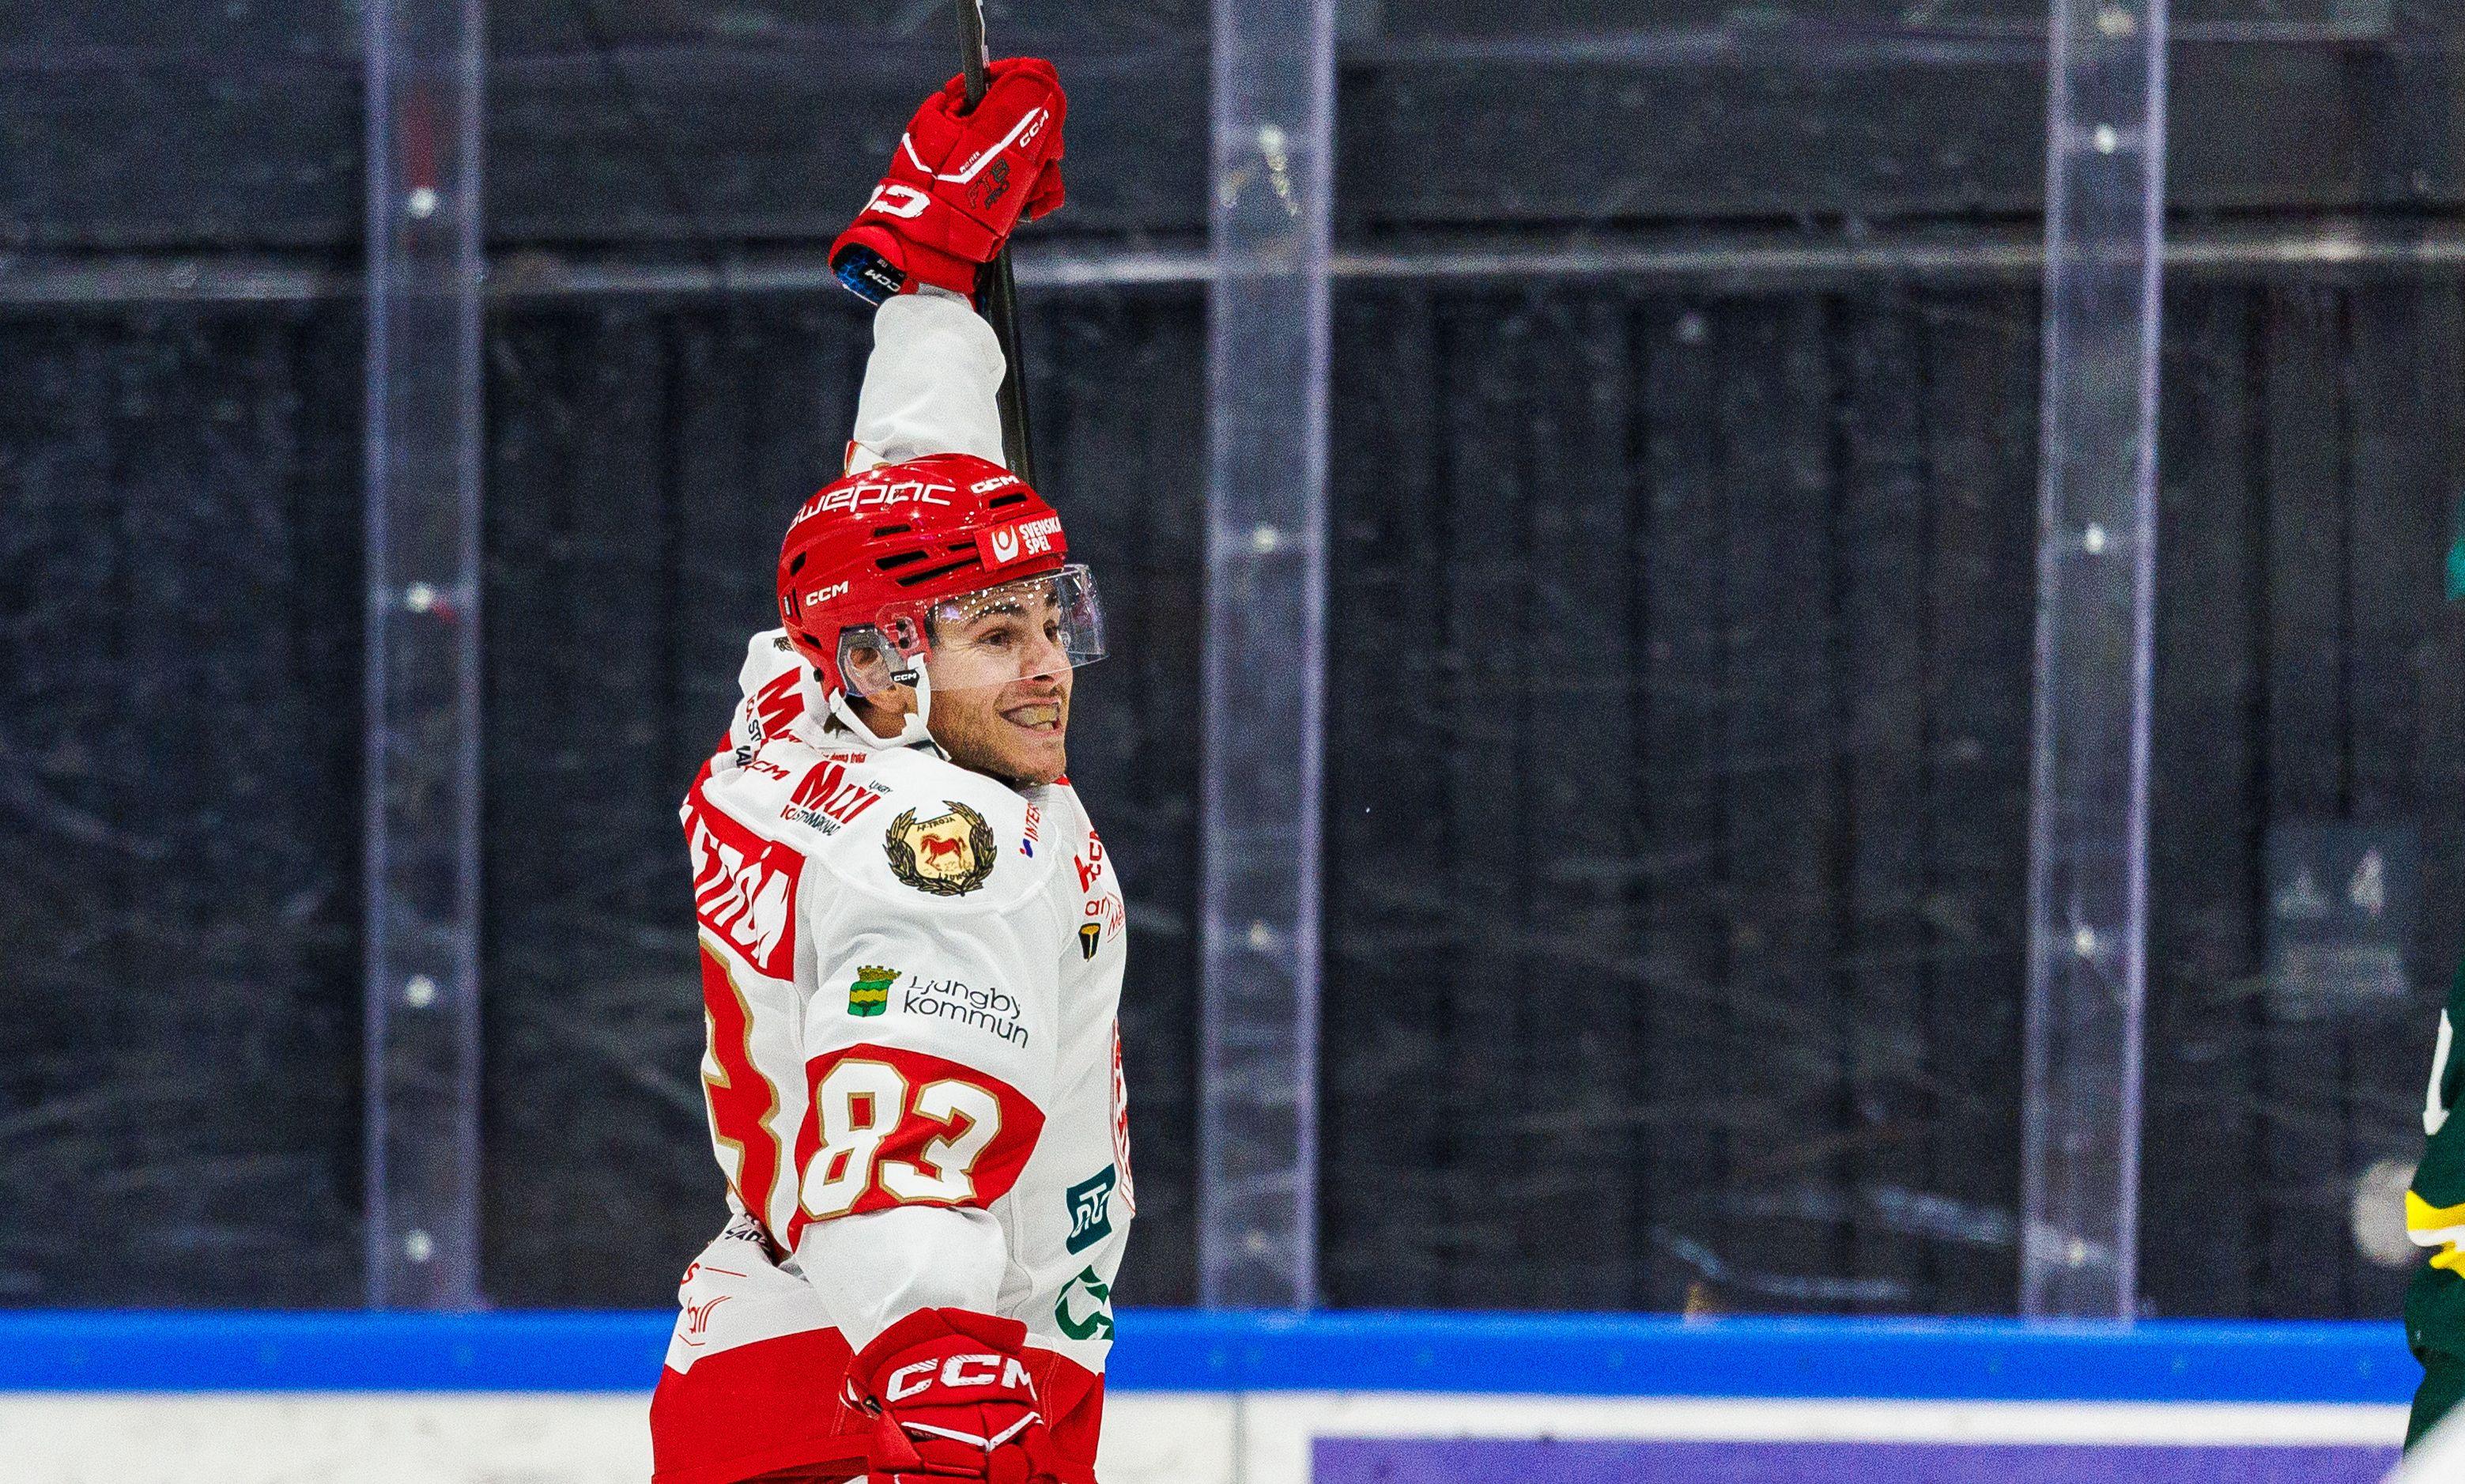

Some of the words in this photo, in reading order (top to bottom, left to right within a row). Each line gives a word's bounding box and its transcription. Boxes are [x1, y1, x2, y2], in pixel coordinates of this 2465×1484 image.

[970, 475, 1020, 494] CCM
[1025, 535, 1052, 555] SPEL
[806, 580, 849, 607] CCM
[893, 671, 917, 682] CCM
[909, 976, 1021, 1020] Ljungby
[903, 989, 1029, 1049] kommun
[798, 1059, 1002, 1221] 83
[885, 1354, 1039, 1403] CCM
